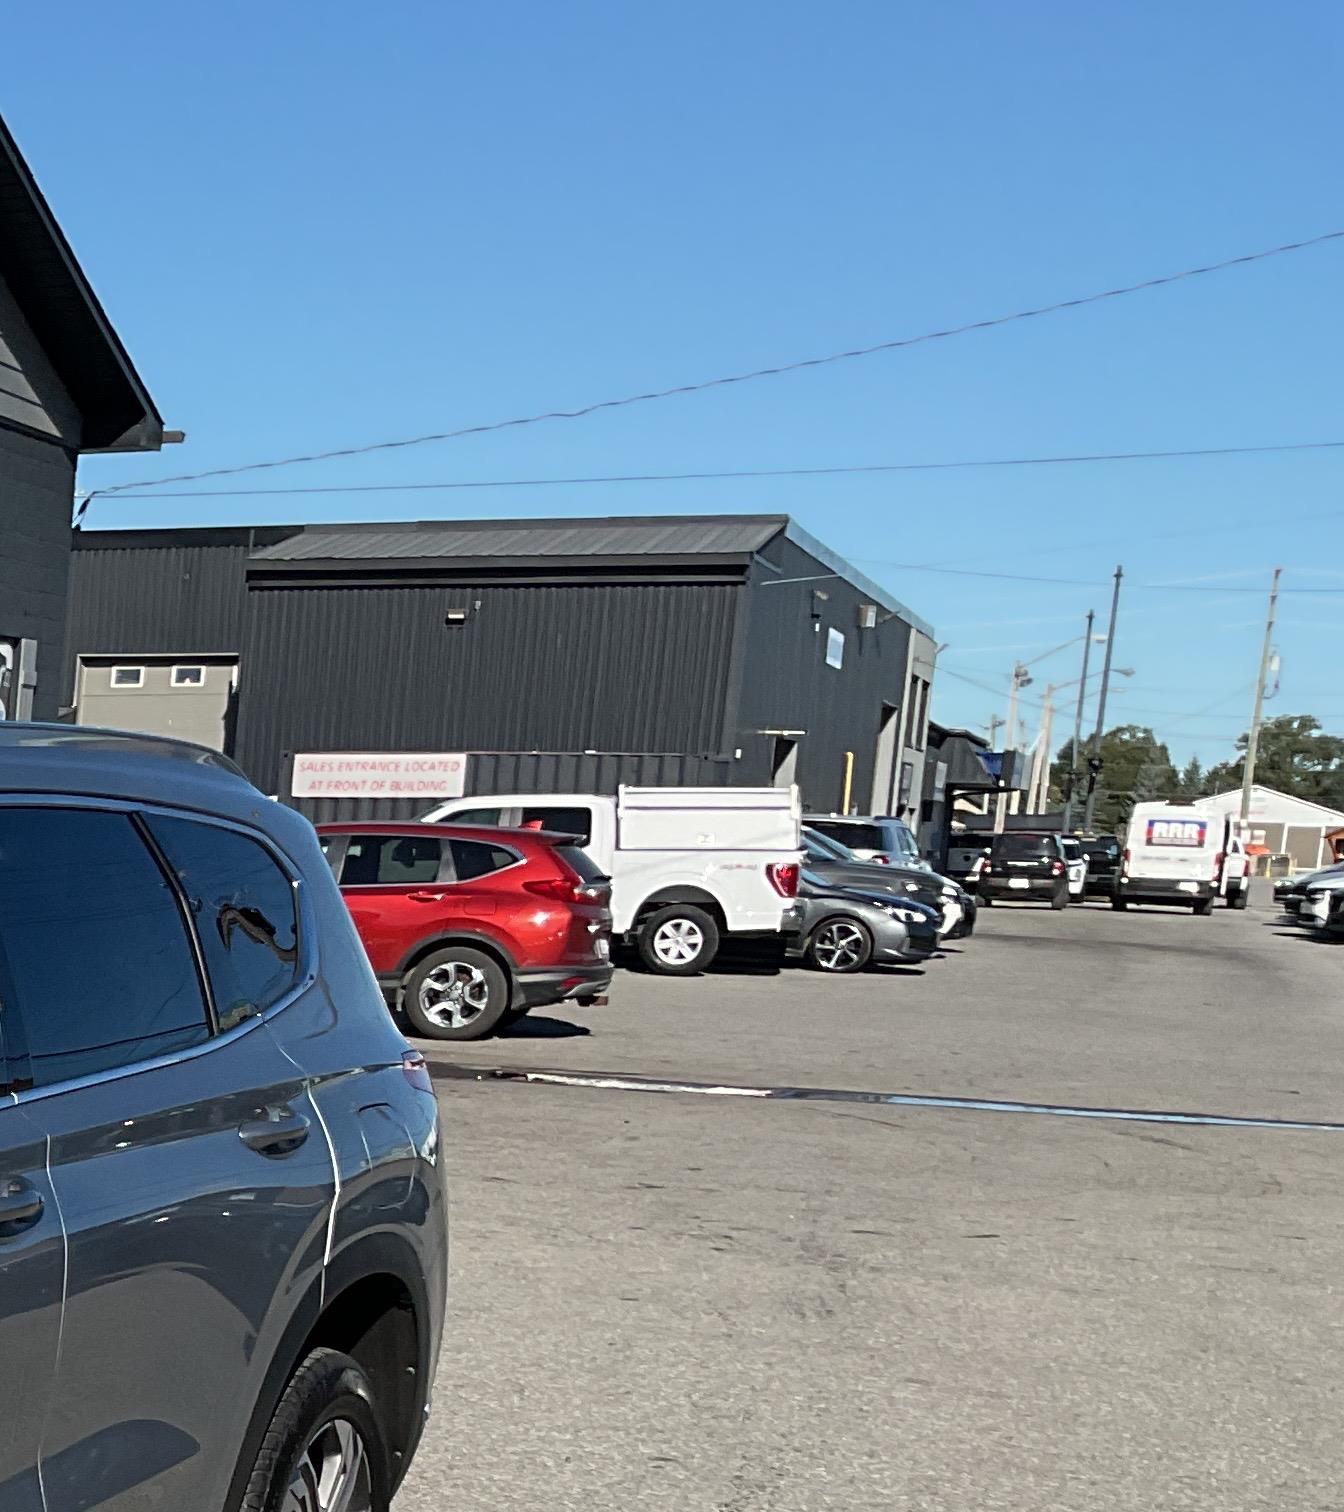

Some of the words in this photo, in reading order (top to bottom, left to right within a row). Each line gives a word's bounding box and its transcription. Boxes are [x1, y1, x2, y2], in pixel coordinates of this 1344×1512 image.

[299, 761, 333, 772] SALES
[337, 760, 400, 772] ENTRANCE
[405, 761, 460, 772] LOCATED
[309, 781, 323, 791] AT
[326, 780, 367, 791] FRONT
[370, 780, 386, 791] OF
[390, 780, 447, 792] BUILDING
